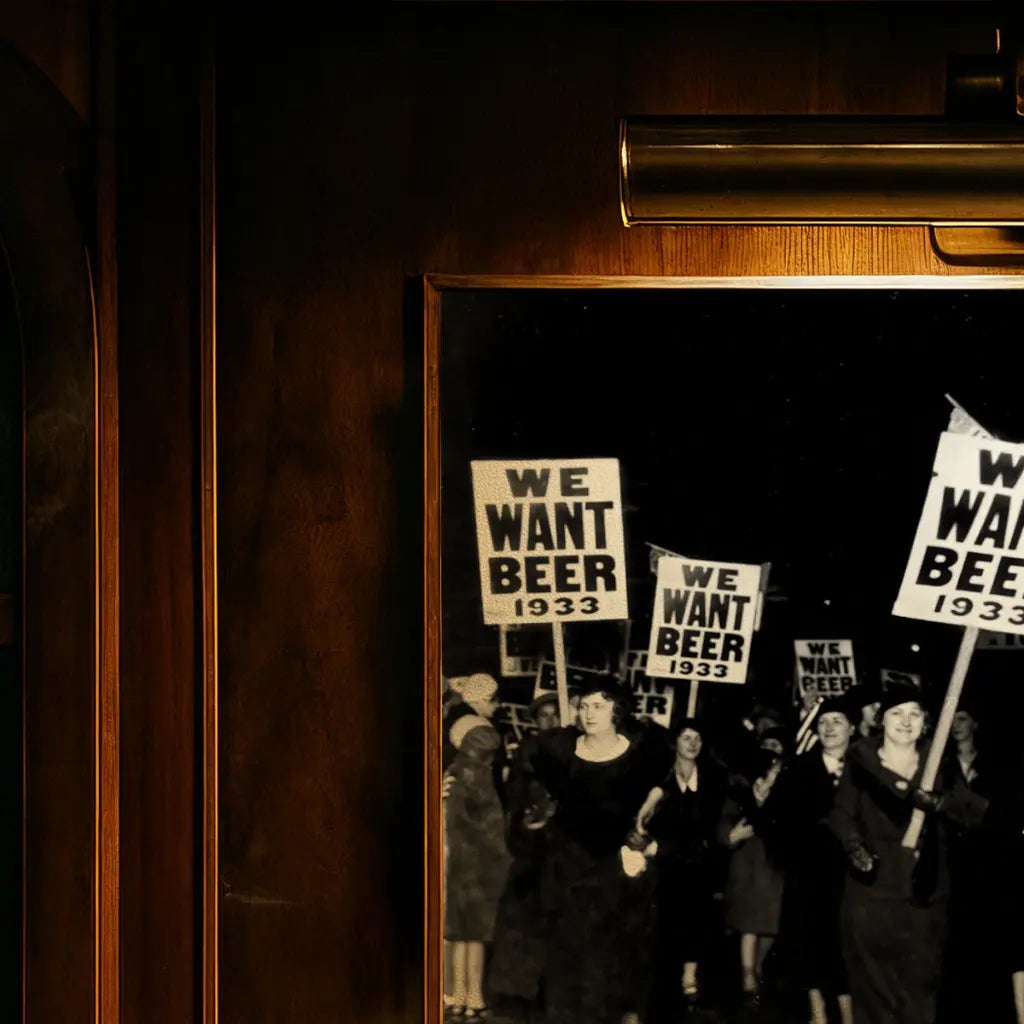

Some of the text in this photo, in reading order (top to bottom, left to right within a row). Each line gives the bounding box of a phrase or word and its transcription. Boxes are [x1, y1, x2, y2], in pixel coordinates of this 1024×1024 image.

[506, 467, 589, 497] WE
[485, 501, 614, 552] WANT
[488, 554, 617, 594] BEER
[682, 564, 739, 591] WE
[515, 597, 600, 617] 1933
[663, 587, 751, 630] WANT
[655, 627, 745, 662] BEER
[808, 642, 840, 655] WE
[669, 660, 728, 678] 1933
[800, 657, 850, 674] WANT
